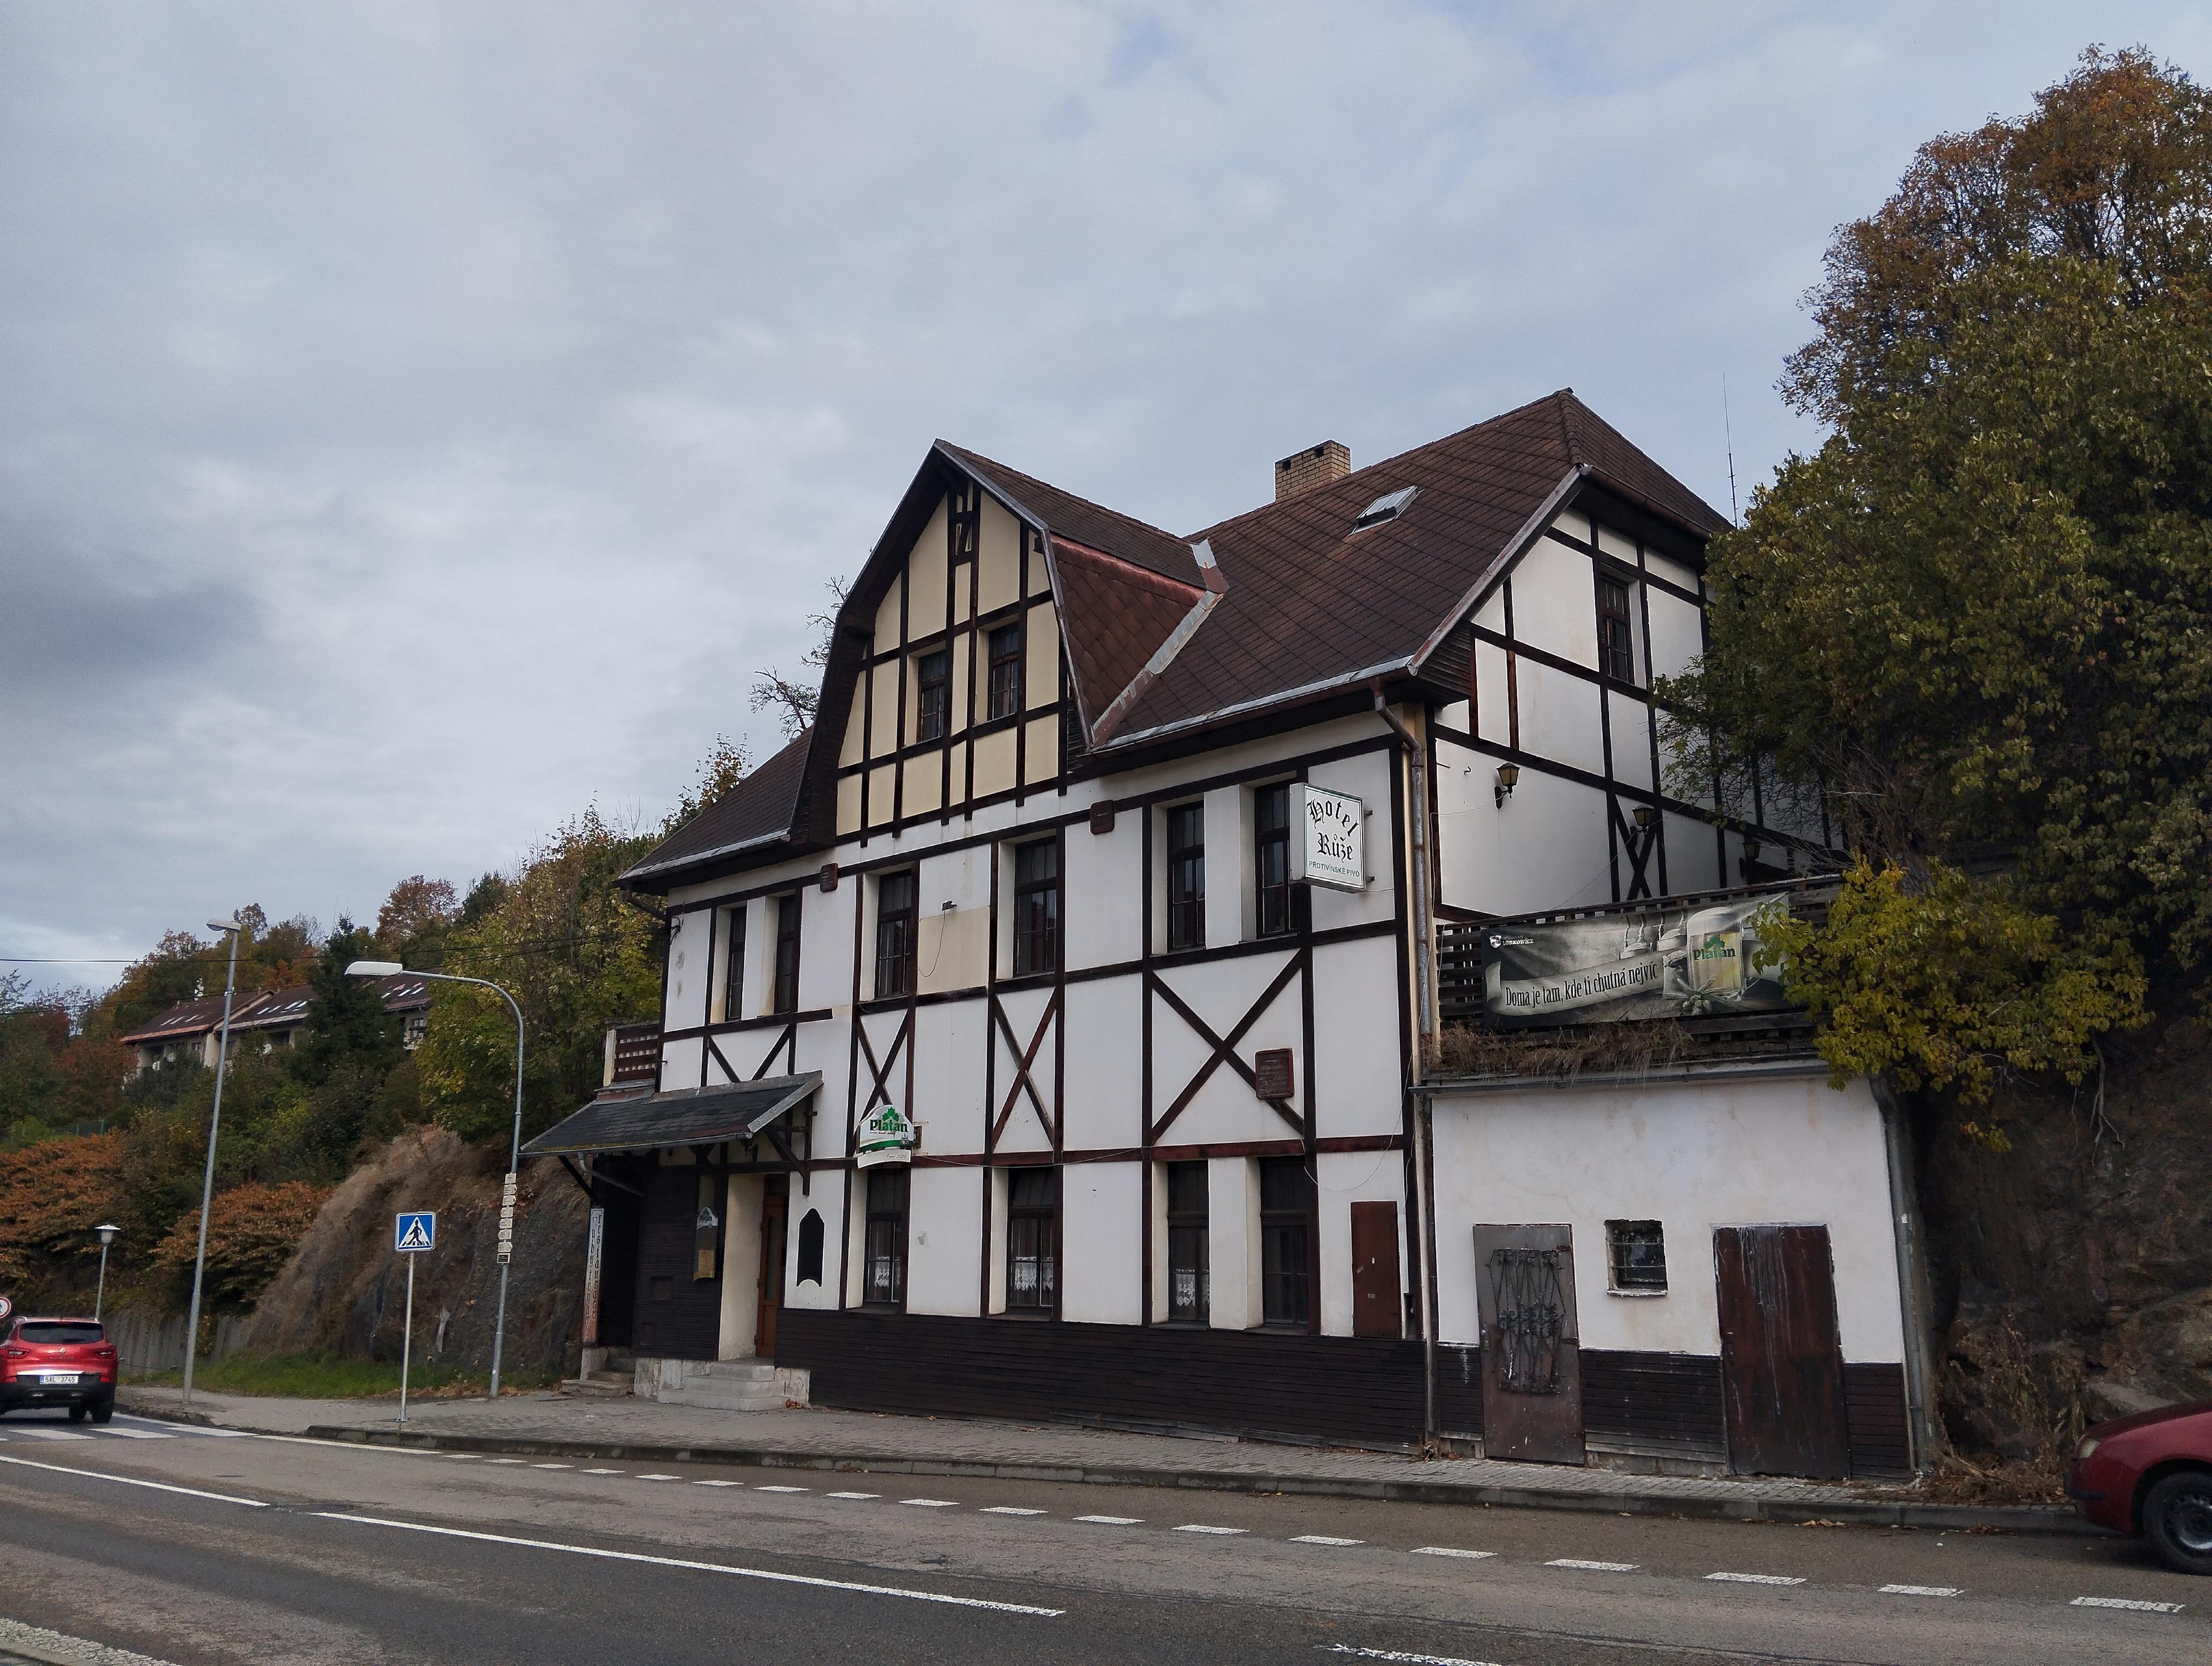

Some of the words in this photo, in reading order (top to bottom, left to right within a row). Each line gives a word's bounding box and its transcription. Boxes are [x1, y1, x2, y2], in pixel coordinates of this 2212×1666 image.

[1306, 798, 1359, 837] Hotel
[1317, 832, 1353, 863] Růže
[1309, 861, 1345, 875] PROTIVÍNSKÉ
[1346, 869, 1360, 877] PIVO
[1693, 946, 1736, 960] Platan
[1505, 987, 1531, 1006] Doma
[1532, 986, 1541, 1008] je
[1542, 986, 1564, 1004] tam,
[1564, 979, 1582, 1000] kde
[1583, 976, 1592, 996] ti
[1593, 967, 1626, 993] chutná
[1628, 961, 1658, 985] nejvíc
[869, 1120, 908, 1132] Platan
